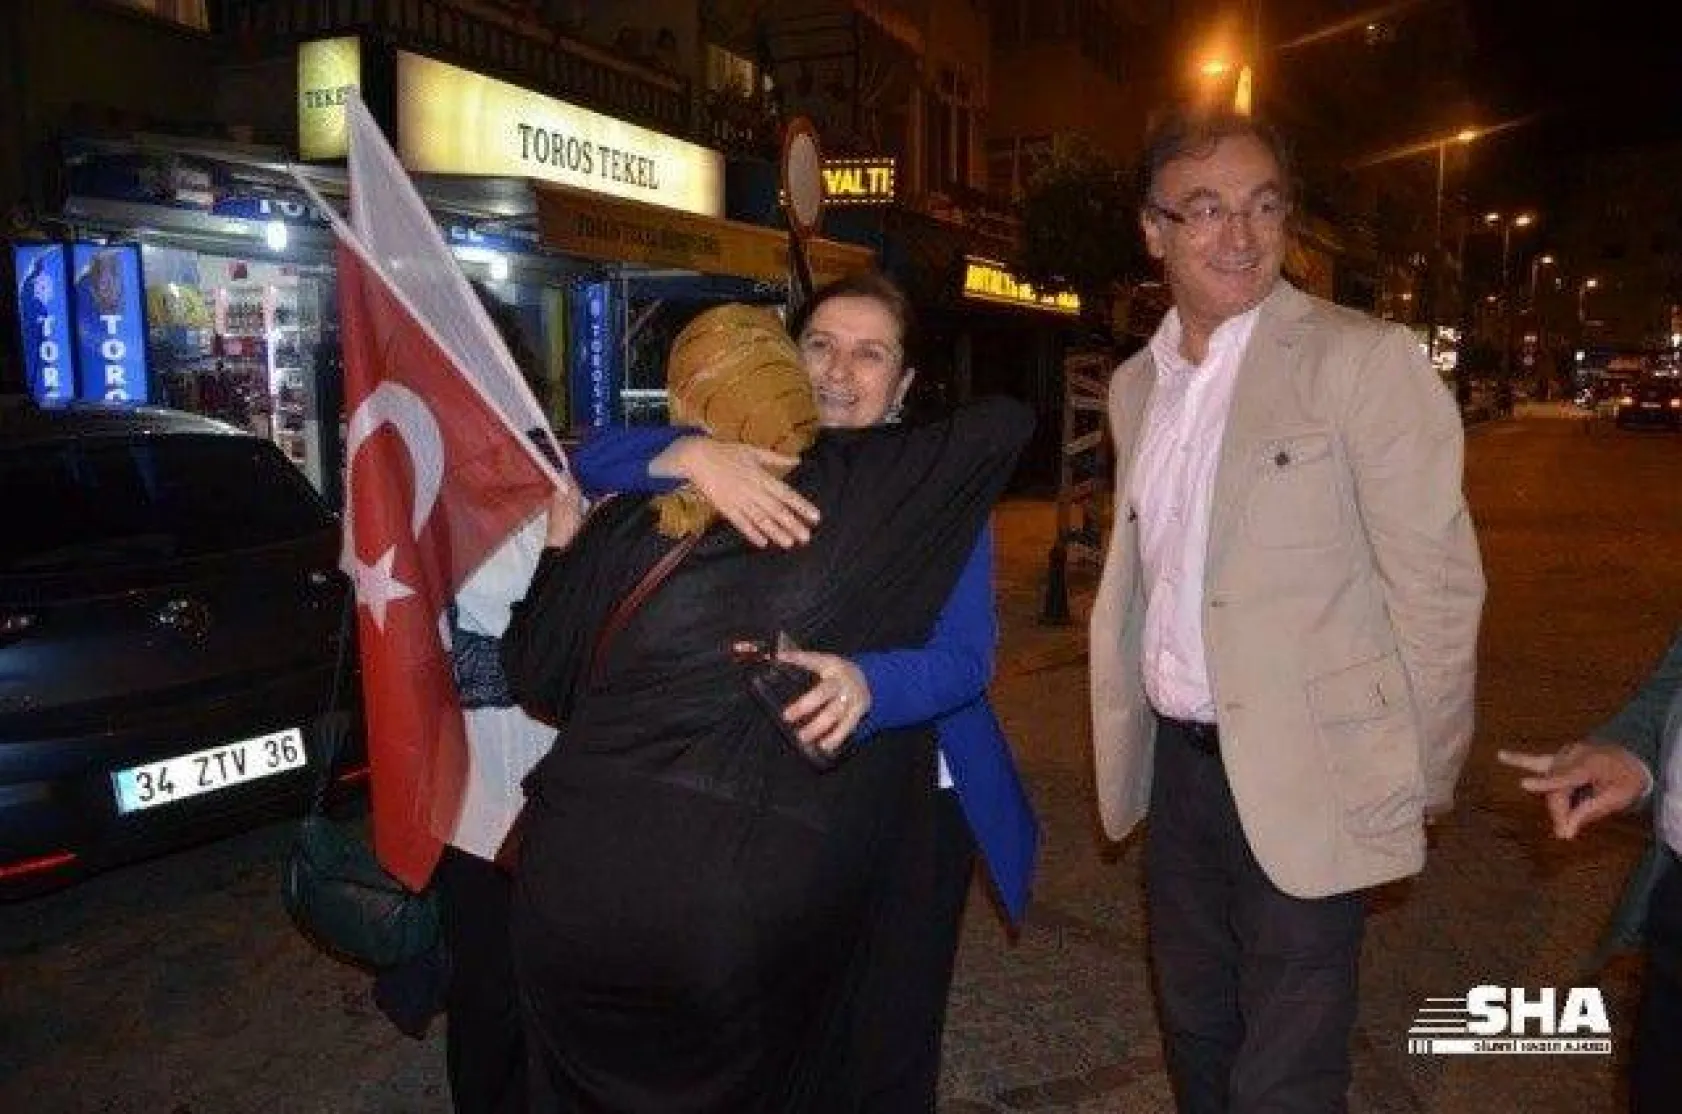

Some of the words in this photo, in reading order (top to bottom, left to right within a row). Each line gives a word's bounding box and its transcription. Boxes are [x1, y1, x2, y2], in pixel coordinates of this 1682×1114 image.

[304, 86, 351, 108] TEKE
[517, 122, 593, 174] TOROS
[597, 145, 660, 190] TEKEL
[822, 167, 890, 195] VALTI
[136, 765, 175, 802] 34
[194, 747, 246, 785] ZTV
[264, 735, 298, 768] 36
